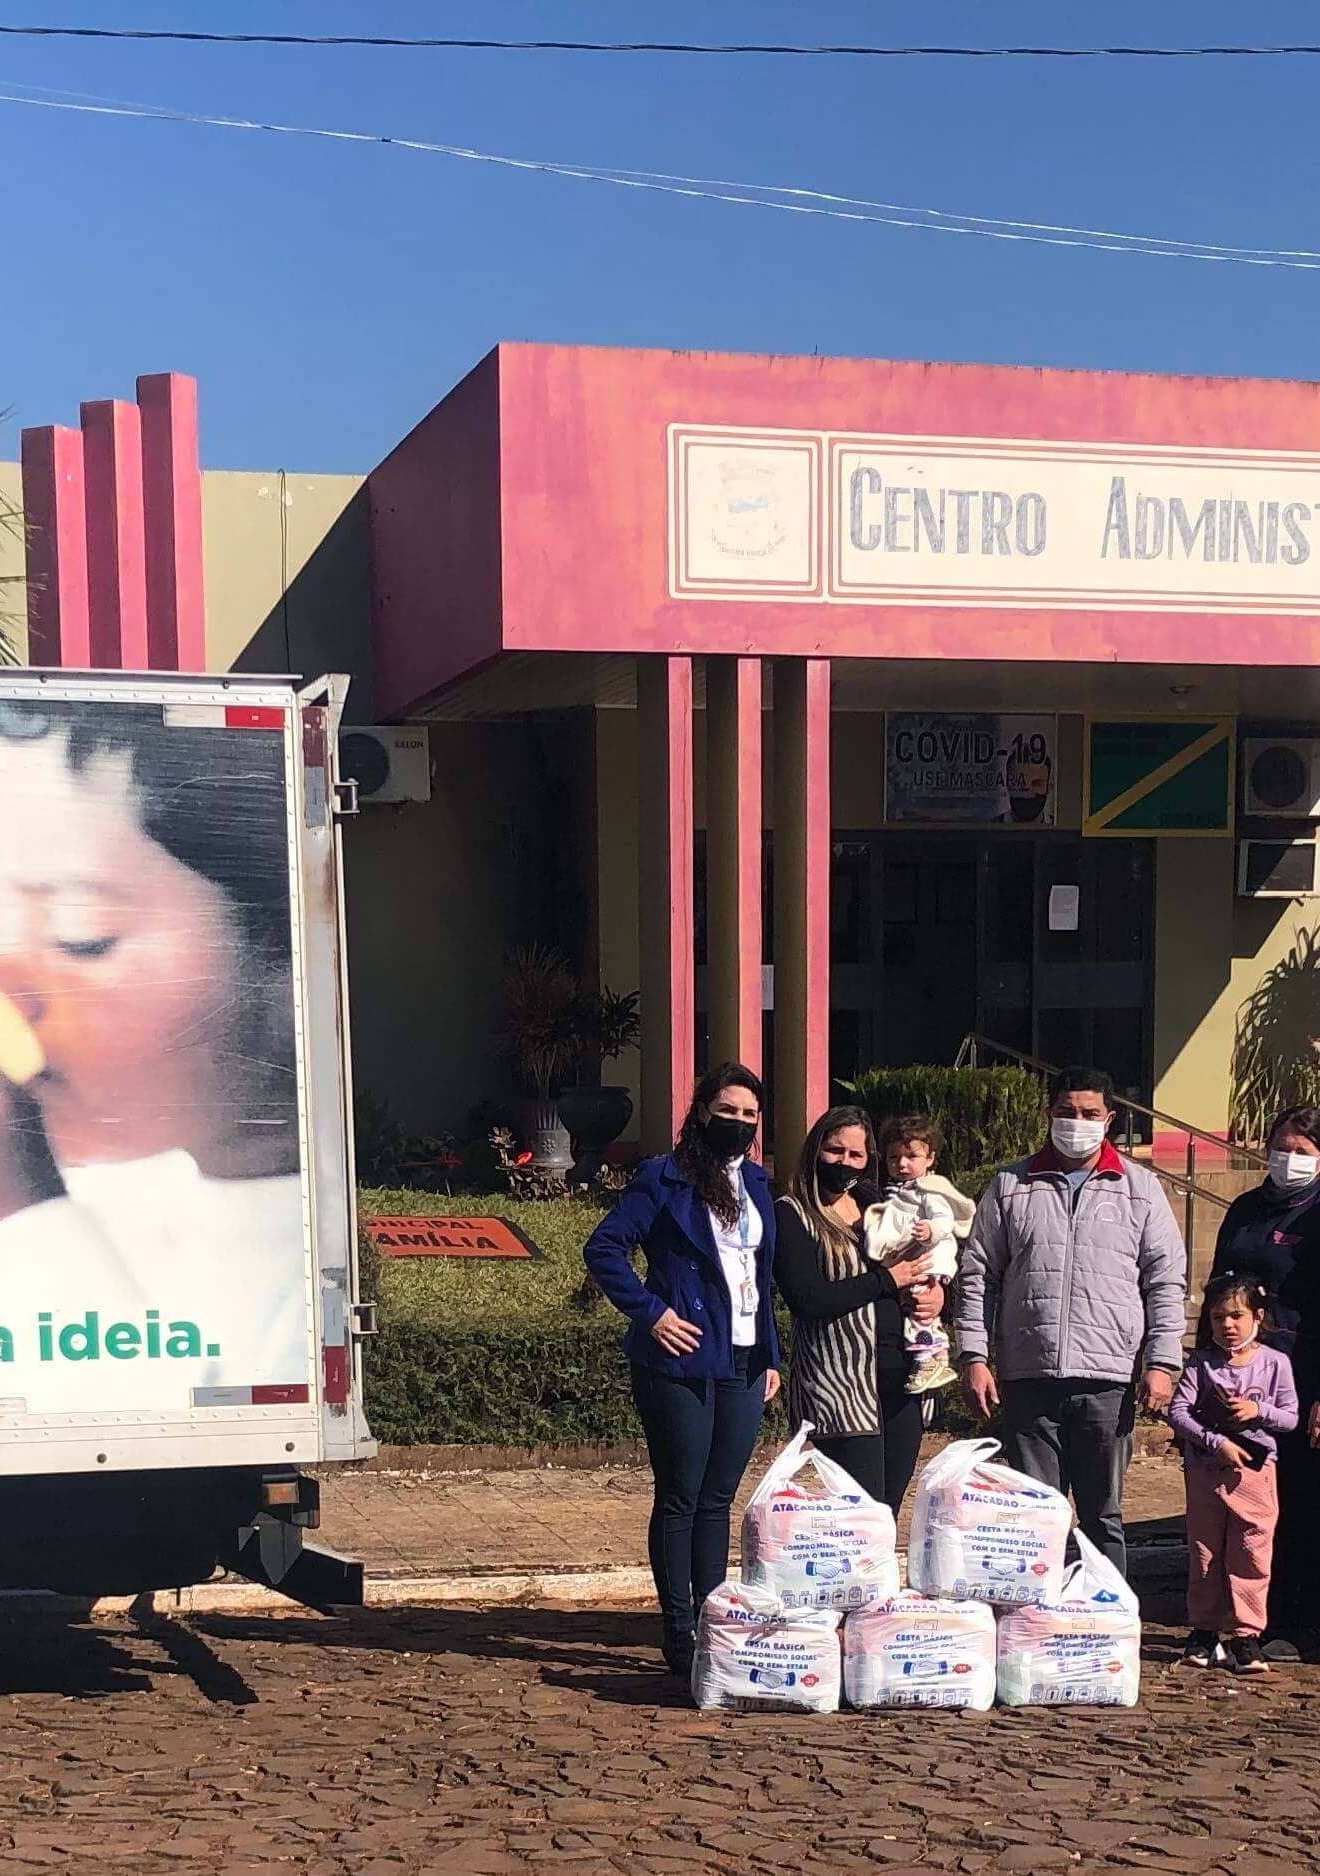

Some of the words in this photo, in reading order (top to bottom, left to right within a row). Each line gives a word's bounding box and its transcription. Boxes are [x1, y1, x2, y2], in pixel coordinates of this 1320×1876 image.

[850, 466, 1047, 557] CENTRO
[895, 731, 1046, 764] COVID-19
[38, 1310, 220, 1361] ideia.
